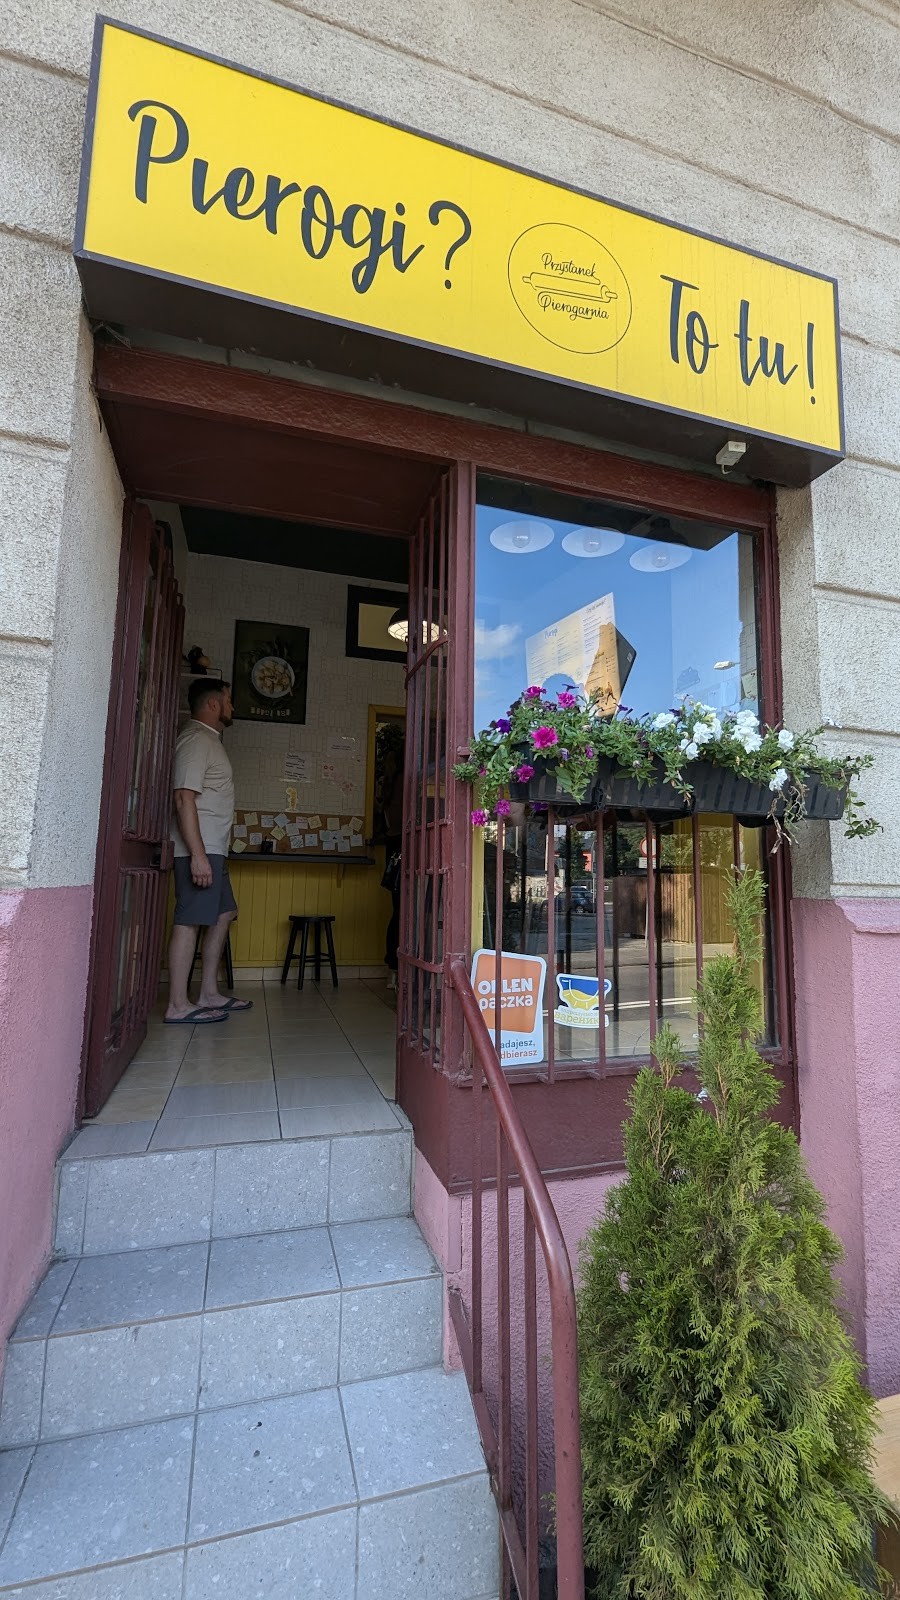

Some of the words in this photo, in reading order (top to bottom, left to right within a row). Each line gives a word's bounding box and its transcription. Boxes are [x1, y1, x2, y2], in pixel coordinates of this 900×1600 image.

[127, 100, 472, 294] Pierogi?
[541, 252, 597, 277] Przystanek
[538, 294, 609, 321] Pierogarnia
[660, 274, 719, 374] To
[733, 299, 816, 405] tu!
[478, 994, 534, 1010] paczka
[500, 1039, 536, 1050] adajesz,
[500, 1050, 538, 1059] dbierasz
